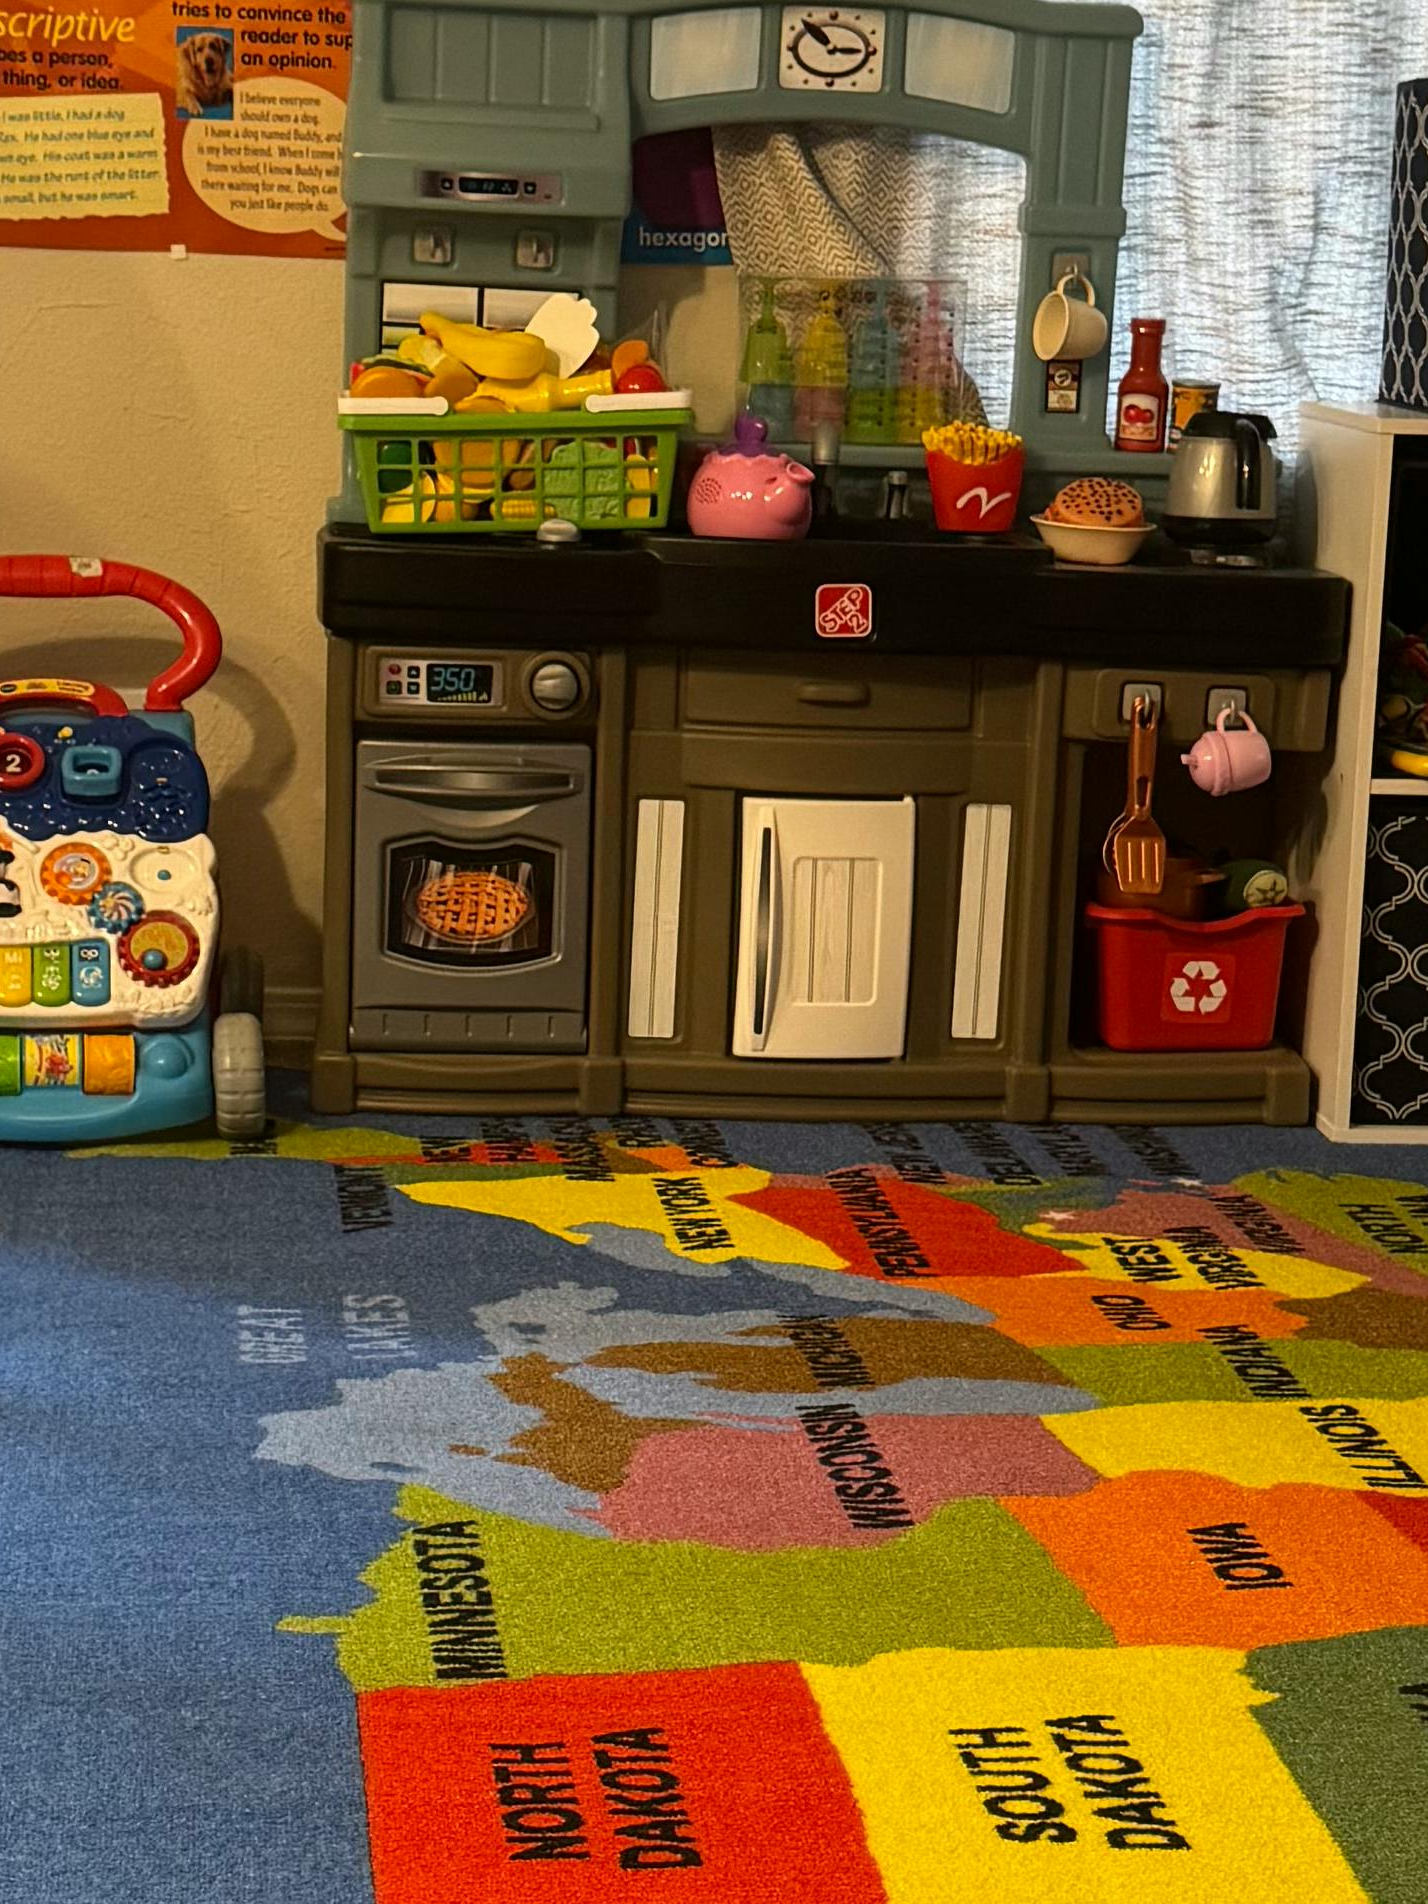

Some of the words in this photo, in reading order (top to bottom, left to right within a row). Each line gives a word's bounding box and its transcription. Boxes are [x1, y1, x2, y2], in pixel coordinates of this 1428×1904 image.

[172, 1, 209, 18] tries
[215, 4, 232, 19] to
[237, 5, 313, 22] convince
[318, 7, 346, 24] the
[241, 28, 298, 44] reader
[303, 30, 320, 46] to
[3, 69, 51, 90] thing,
[58, 75, 77, 87] or
[81, 72, 124, 90] idea.
[32, 50, 43, 63] a
[49, 51, 113, 68] person,
[241, 52, 263, 66] an
[268, 52, 337, 70] opinion.
[820, 587, 863, 632] STEP
[846, 611, 868, 633] 2
[431, 667, 475, 691] 350
[5, 754, 22, 773] 2
[334, 1164, 394, 1233] VERMONT
[653, 1176, 718, 1215] YORK
[825, 1167, 936, 1278] PENNSYLVANIA
[1211, 1193, 1305, 1254] VIRGINIA
[665, 1217, 736, 1251] NEW
[1103, 1235, 1180, 1284] WEST
[1165, 1225, 1266, 1290] VIRGINIA
[238, 1304, 306, 1366] GREAT
[344, 1293, 416, 1360] LAKES
[1092, 1293, 1173, 1333] OHIO
[780, 1314, 876, 1389] MICHIGAN
[1202, 1324, 1314, 1401] INDIANA
[796, 1402, 916, 1531] WISCONSIN
[1186, 1521, 1295, 1591] IOWA
[412, 1518, 508, 1681] MINNESOTA
[489, 1740, 591, 1864] NORTH
[588, 1725, 704, 1873] DAKOTA
[947, 1725, 1075, 1845] SOUTH
[1044, 1712, 1193, 1853] DAKOTA
